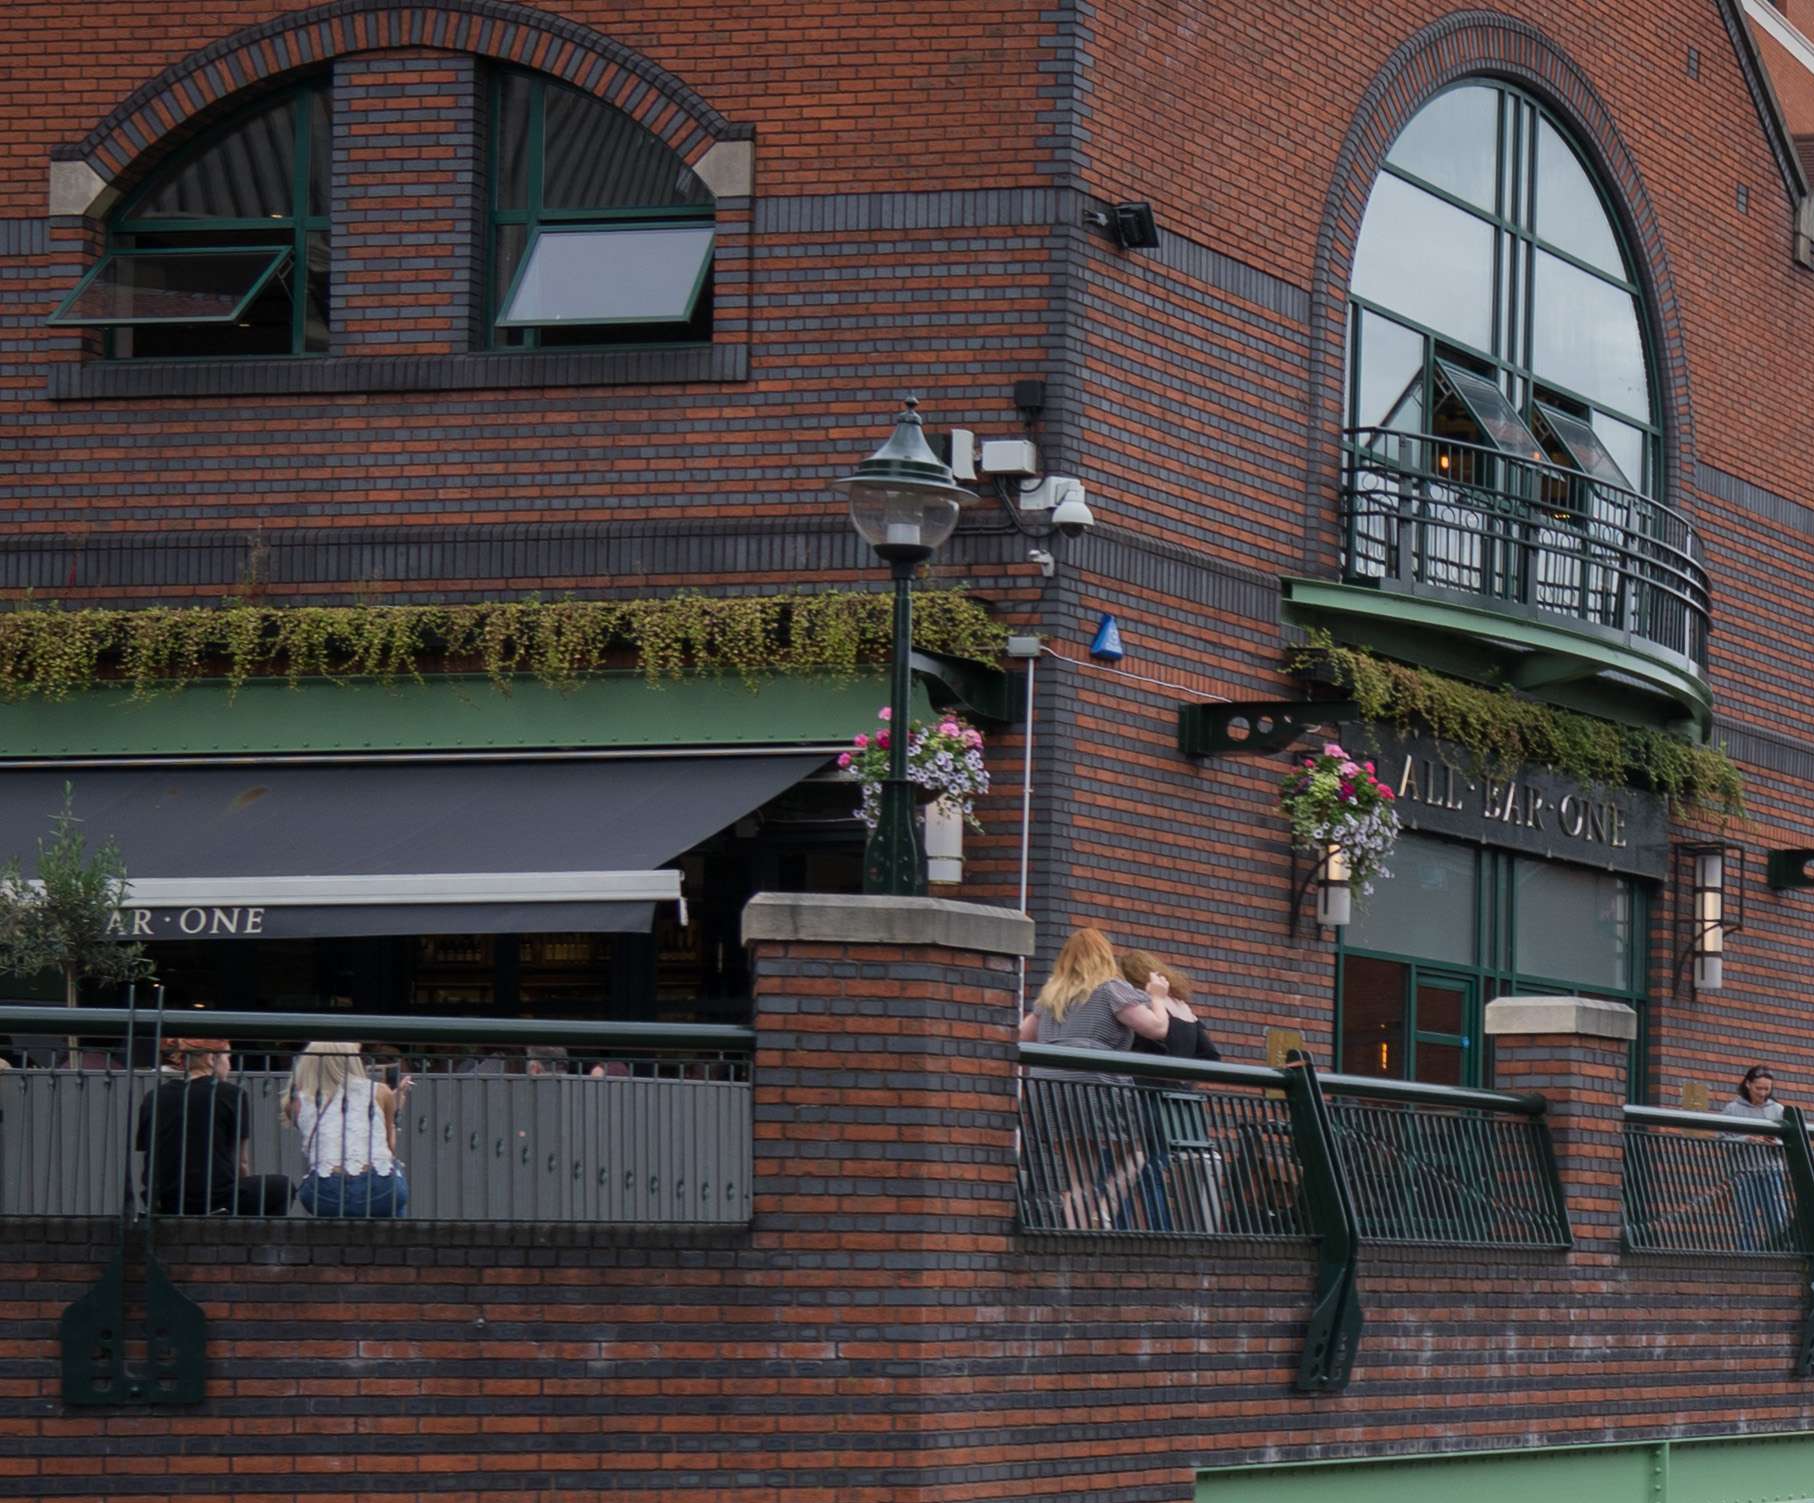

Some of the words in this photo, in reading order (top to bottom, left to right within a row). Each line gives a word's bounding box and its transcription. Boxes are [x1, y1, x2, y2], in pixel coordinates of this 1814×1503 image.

[1398, 755, 1462, 810] ALL
[1561, 793, 1626, 848] ONE
[180, 907, 265, 935] ONE
